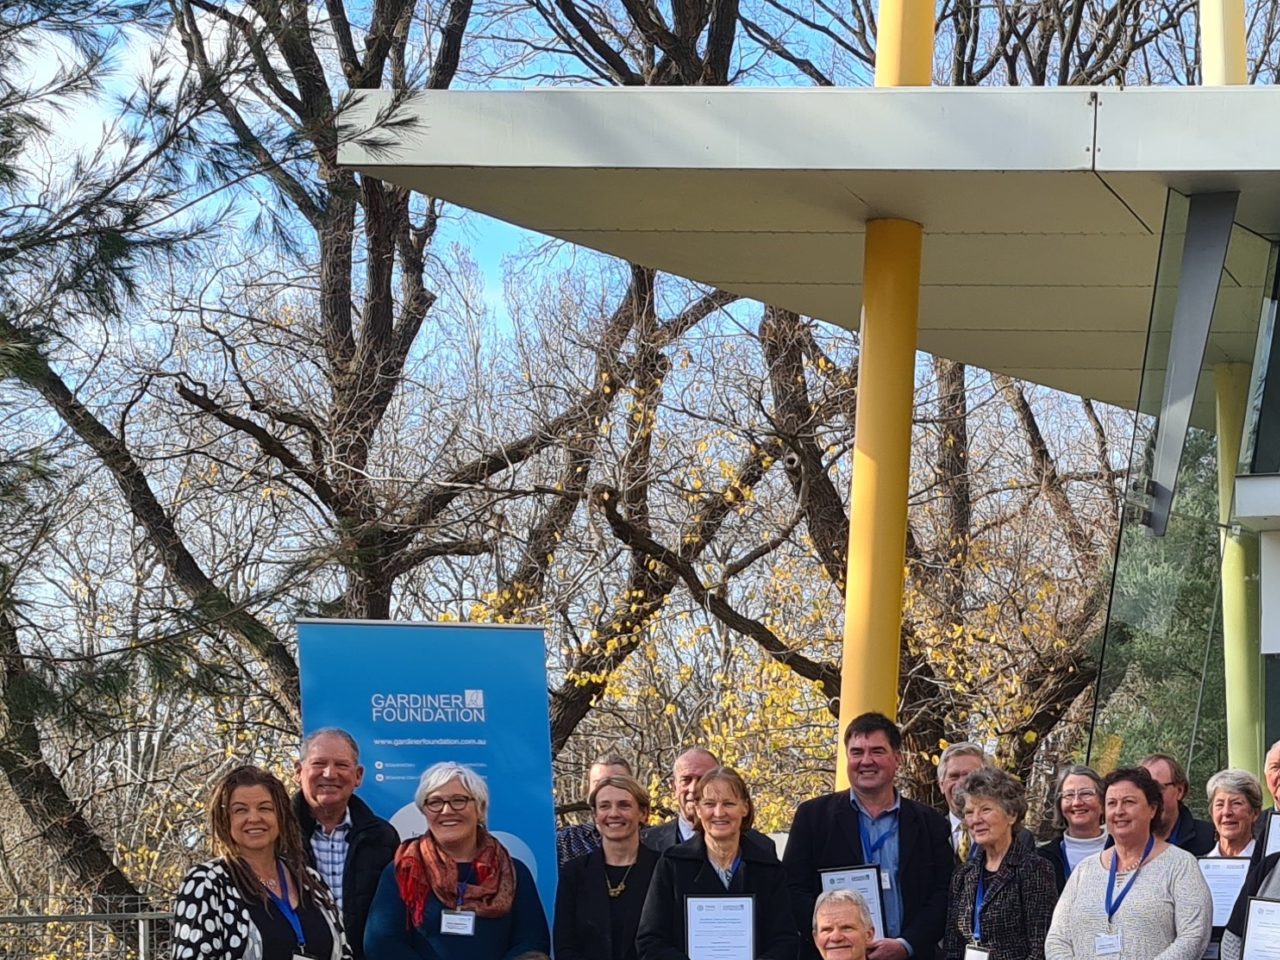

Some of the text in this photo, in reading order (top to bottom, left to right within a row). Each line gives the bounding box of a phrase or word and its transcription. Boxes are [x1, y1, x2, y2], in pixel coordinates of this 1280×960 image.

[371, 693, 464, 708] GARDINER
[372, 707, 485, 722] FOUNDATION
[373, 738, 487, 747] www.gardinerfoundation.com.au
